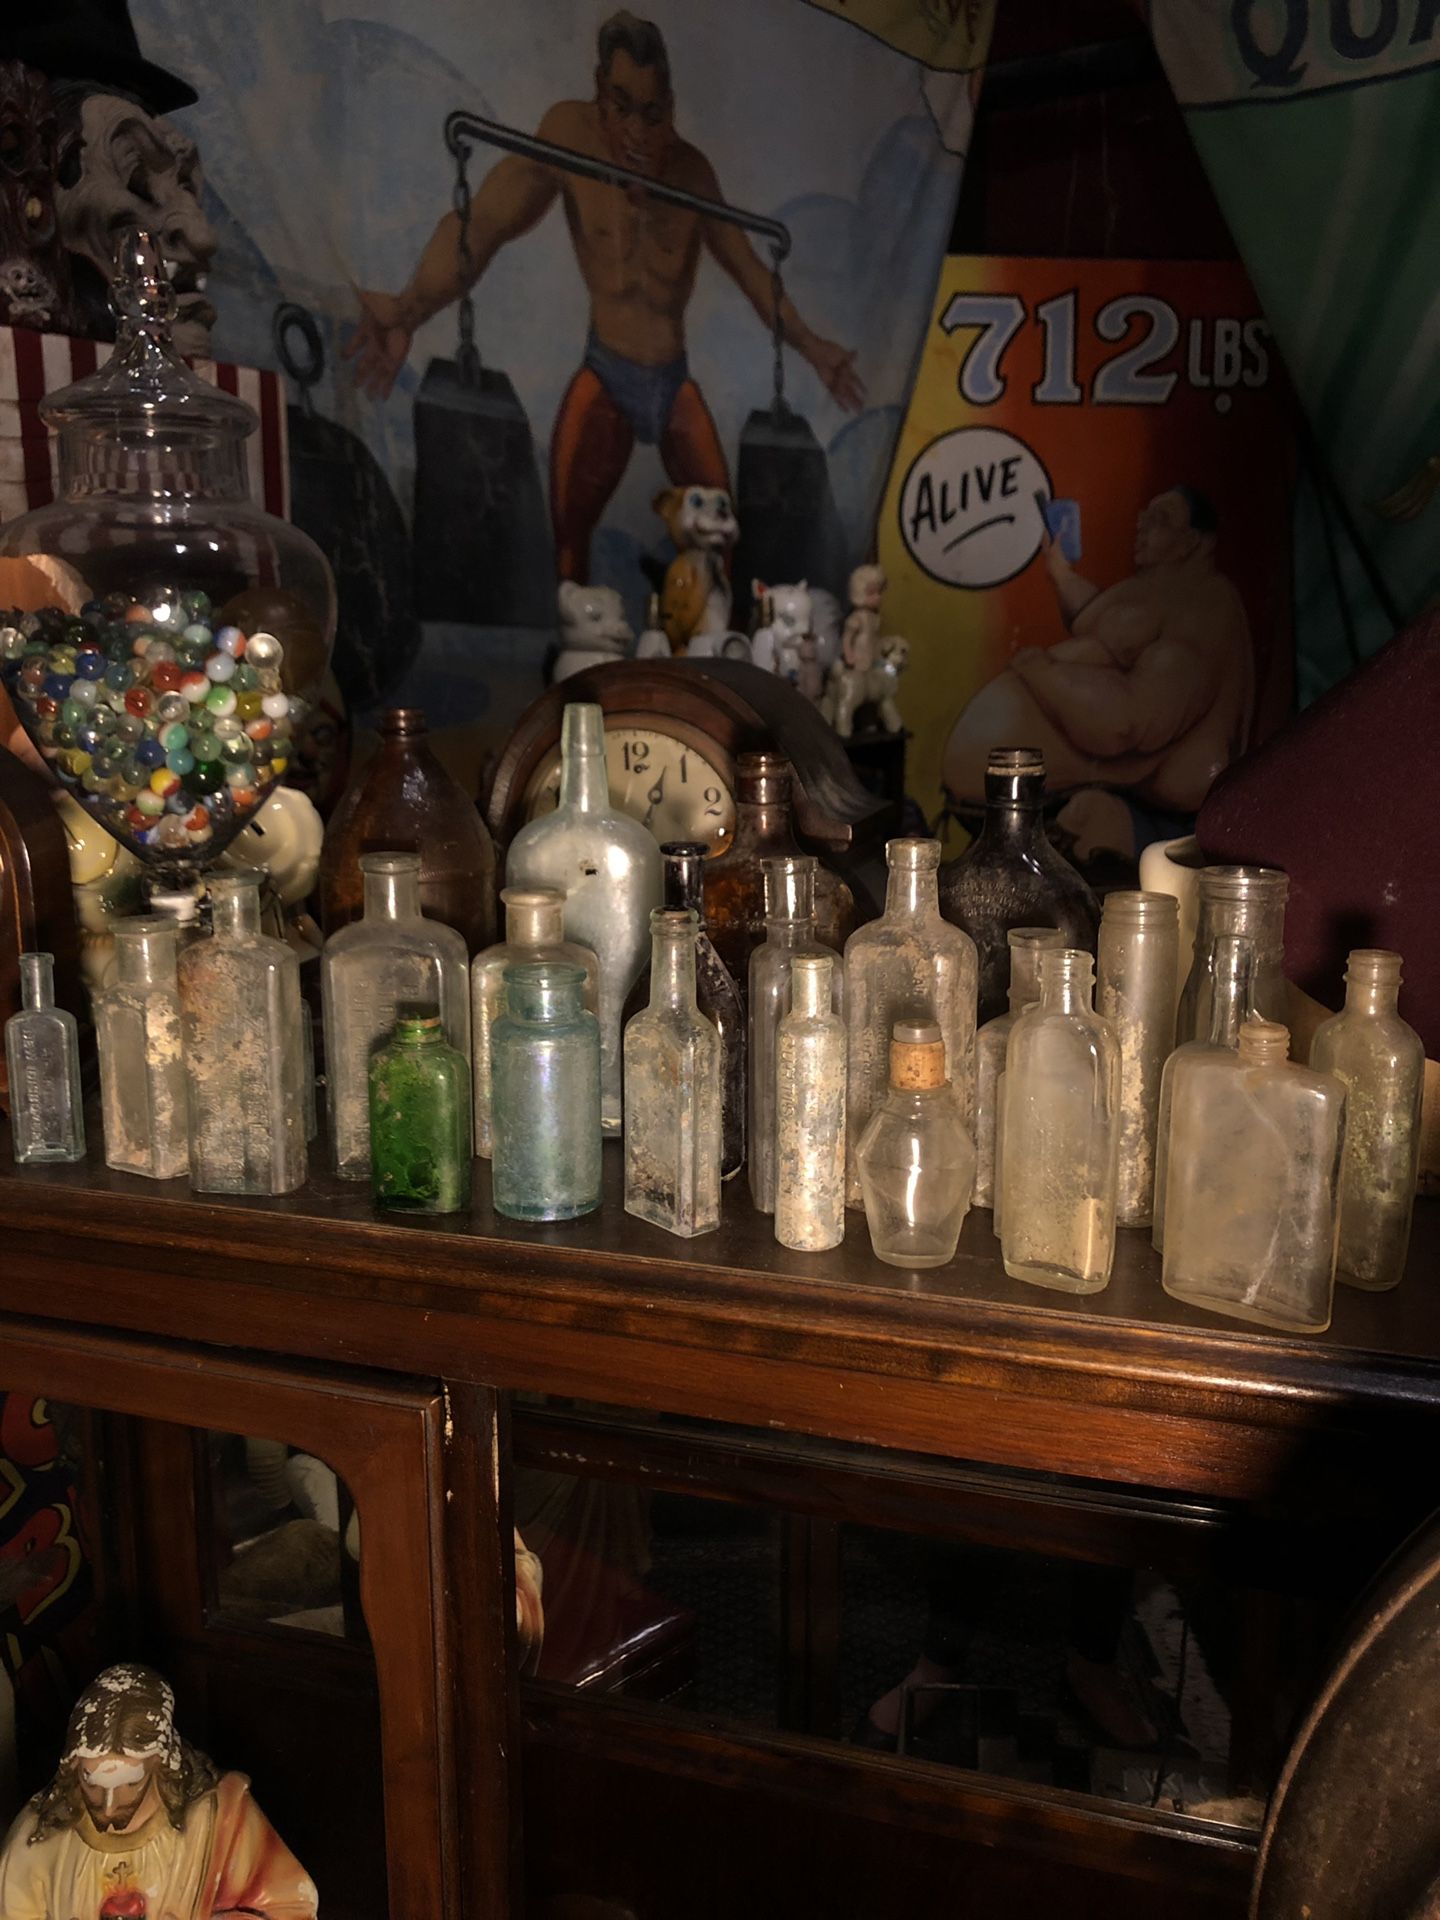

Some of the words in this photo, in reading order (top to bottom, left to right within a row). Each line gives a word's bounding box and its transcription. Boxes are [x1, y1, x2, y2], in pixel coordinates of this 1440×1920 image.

[940, 287, 1181, 406] 712
[1187, 317, 1270, 389] LBS
[911, 454, 1022, 541] ALIVE
[621, 741, 650, 774] 12
[679, 754, 688, 784] 1
[703, 786, 722, 816] 2
